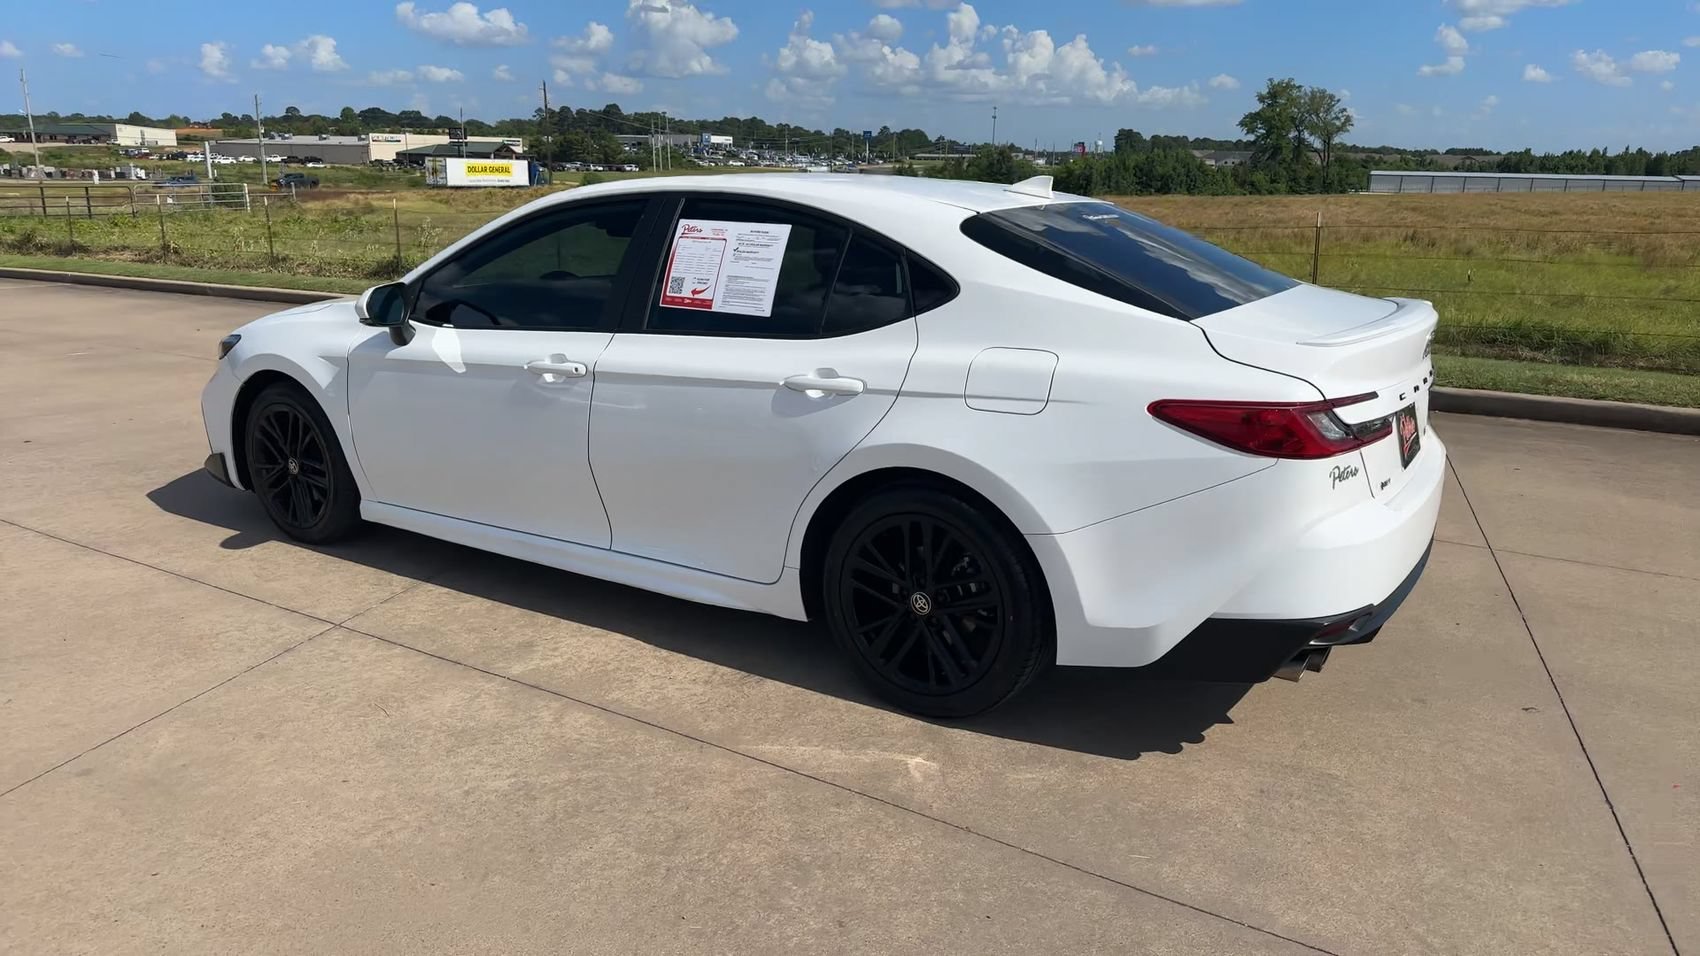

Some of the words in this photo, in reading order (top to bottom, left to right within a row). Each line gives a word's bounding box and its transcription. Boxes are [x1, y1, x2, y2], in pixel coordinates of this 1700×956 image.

[467, 165, 488, 174] DOLLAR
[488, 165, 511, 174] GENERAL
[1329, 465, 1360, 490] Peters
